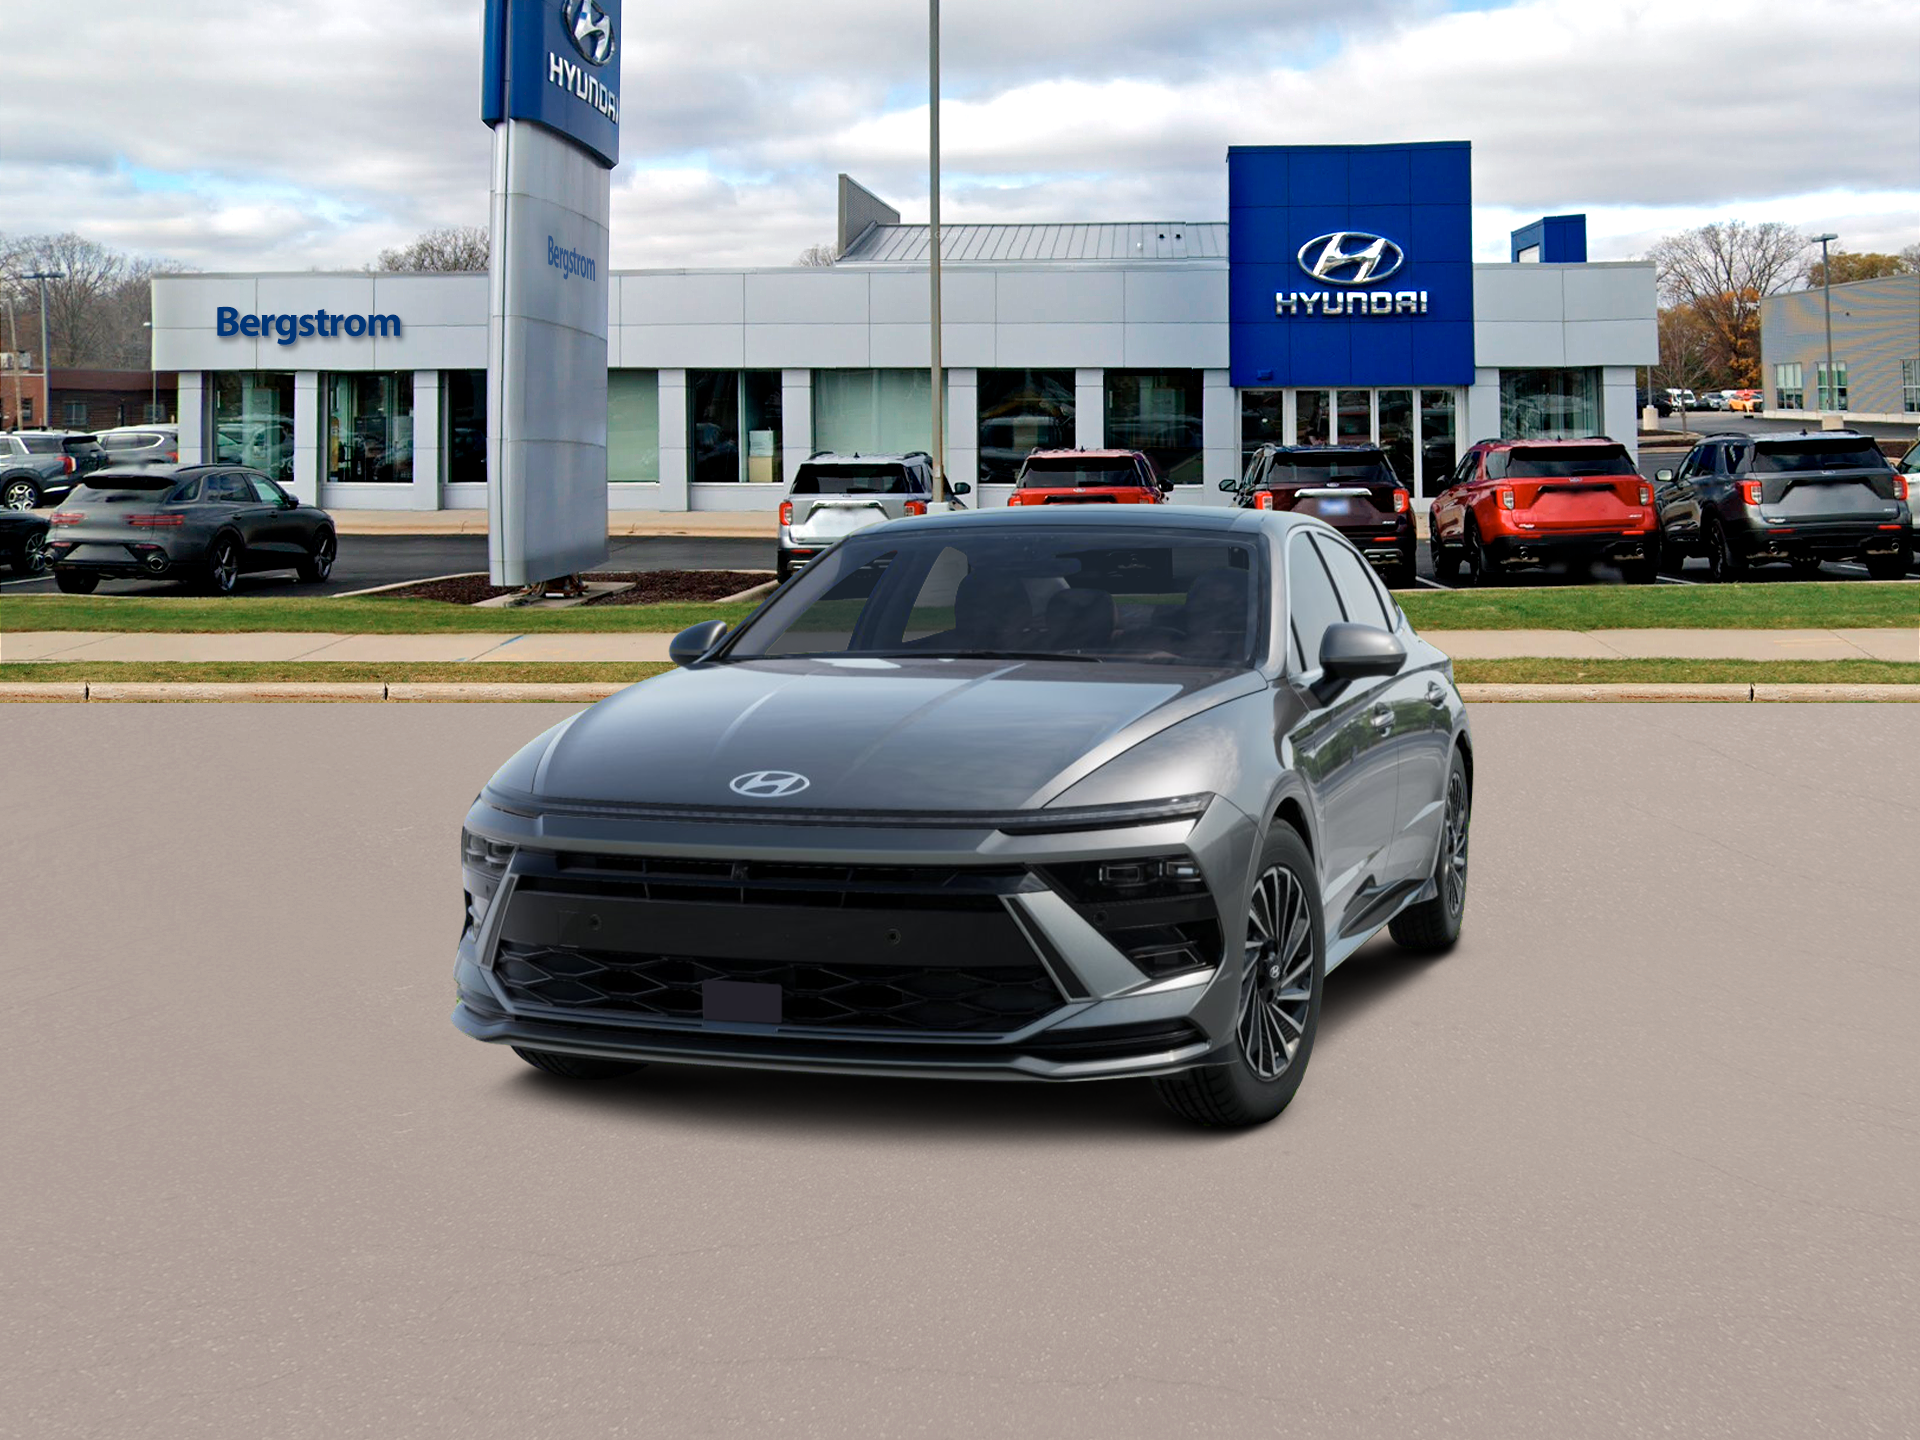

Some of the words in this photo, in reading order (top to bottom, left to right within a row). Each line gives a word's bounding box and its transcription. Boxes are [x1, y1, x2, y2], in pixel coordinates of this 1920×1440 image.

[548, 52, 619, 124] HYUNDAI
[547, 235, 596, 282] Bergstrom
[1275, 290, 1428, 316] HYUNDAI
[216, 306, 402, 346] Bergstrom
